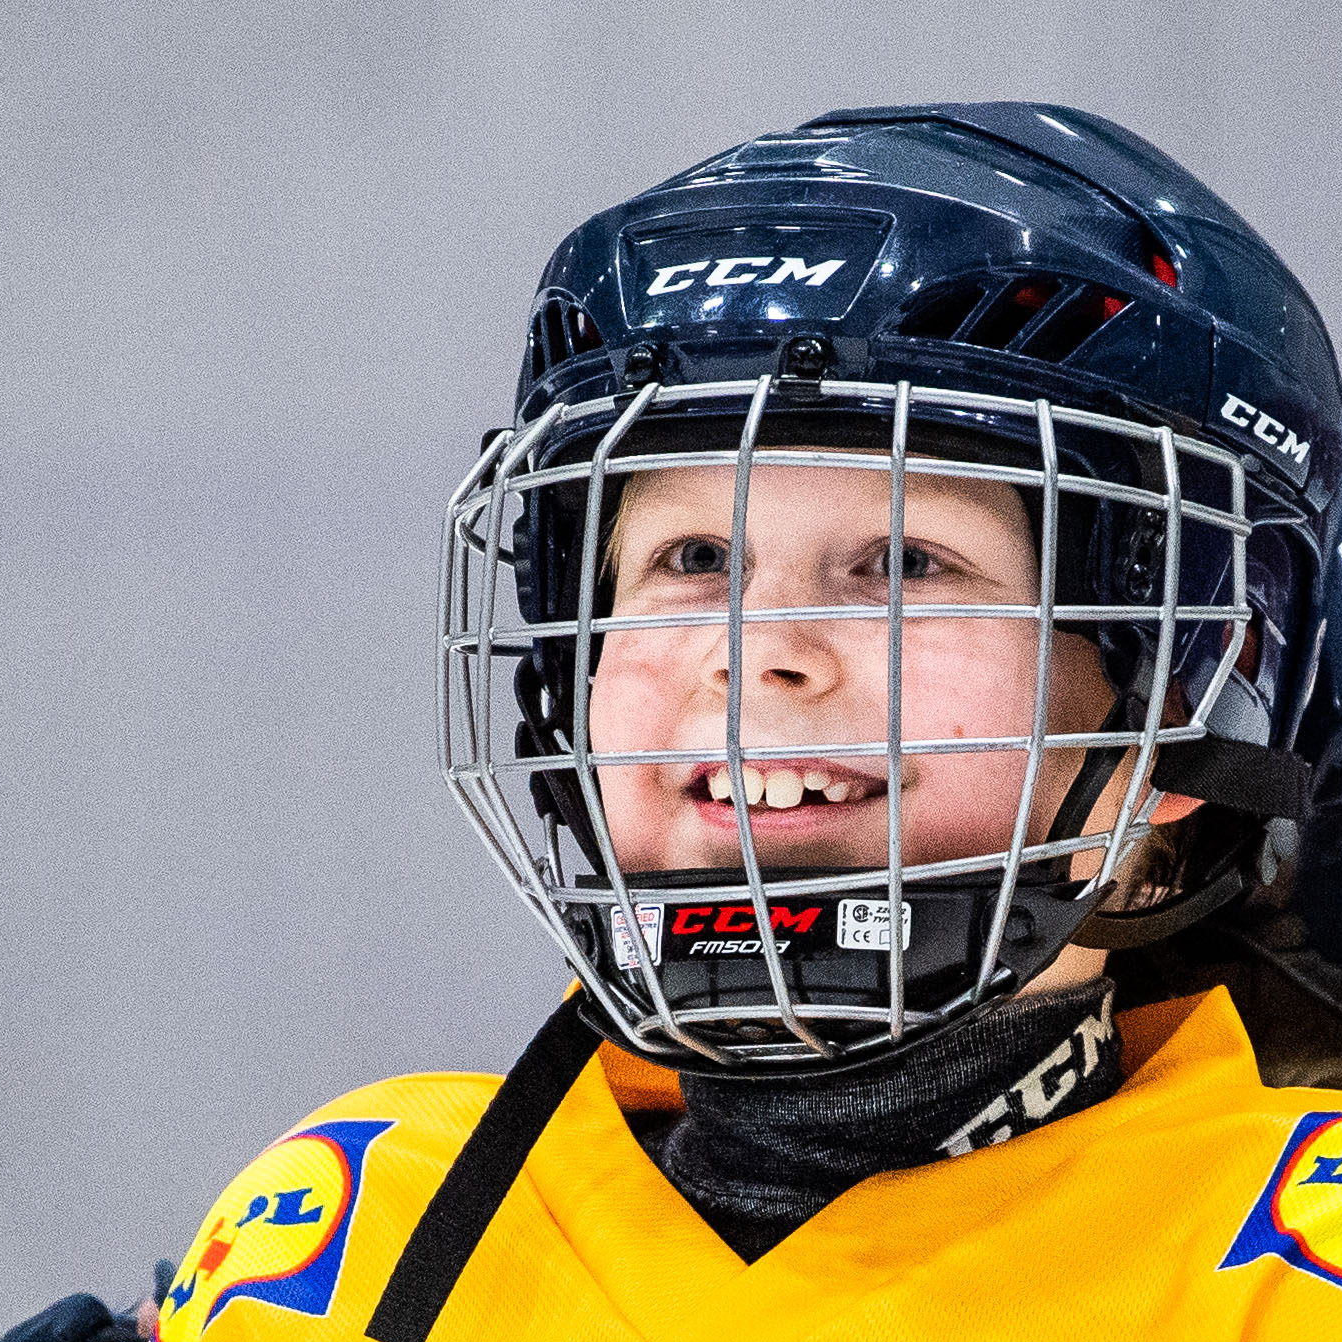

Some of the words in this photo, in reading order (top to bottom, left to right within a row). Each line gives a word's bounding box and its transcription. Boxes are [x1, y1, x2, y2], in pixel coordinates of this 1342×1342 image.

[646, 256, 847, 297] CCM
[1218, 392, 1313, 465] CCM
[671, 905, 822, 935] CCM
[936, 990, 1114, 1157] CCM
